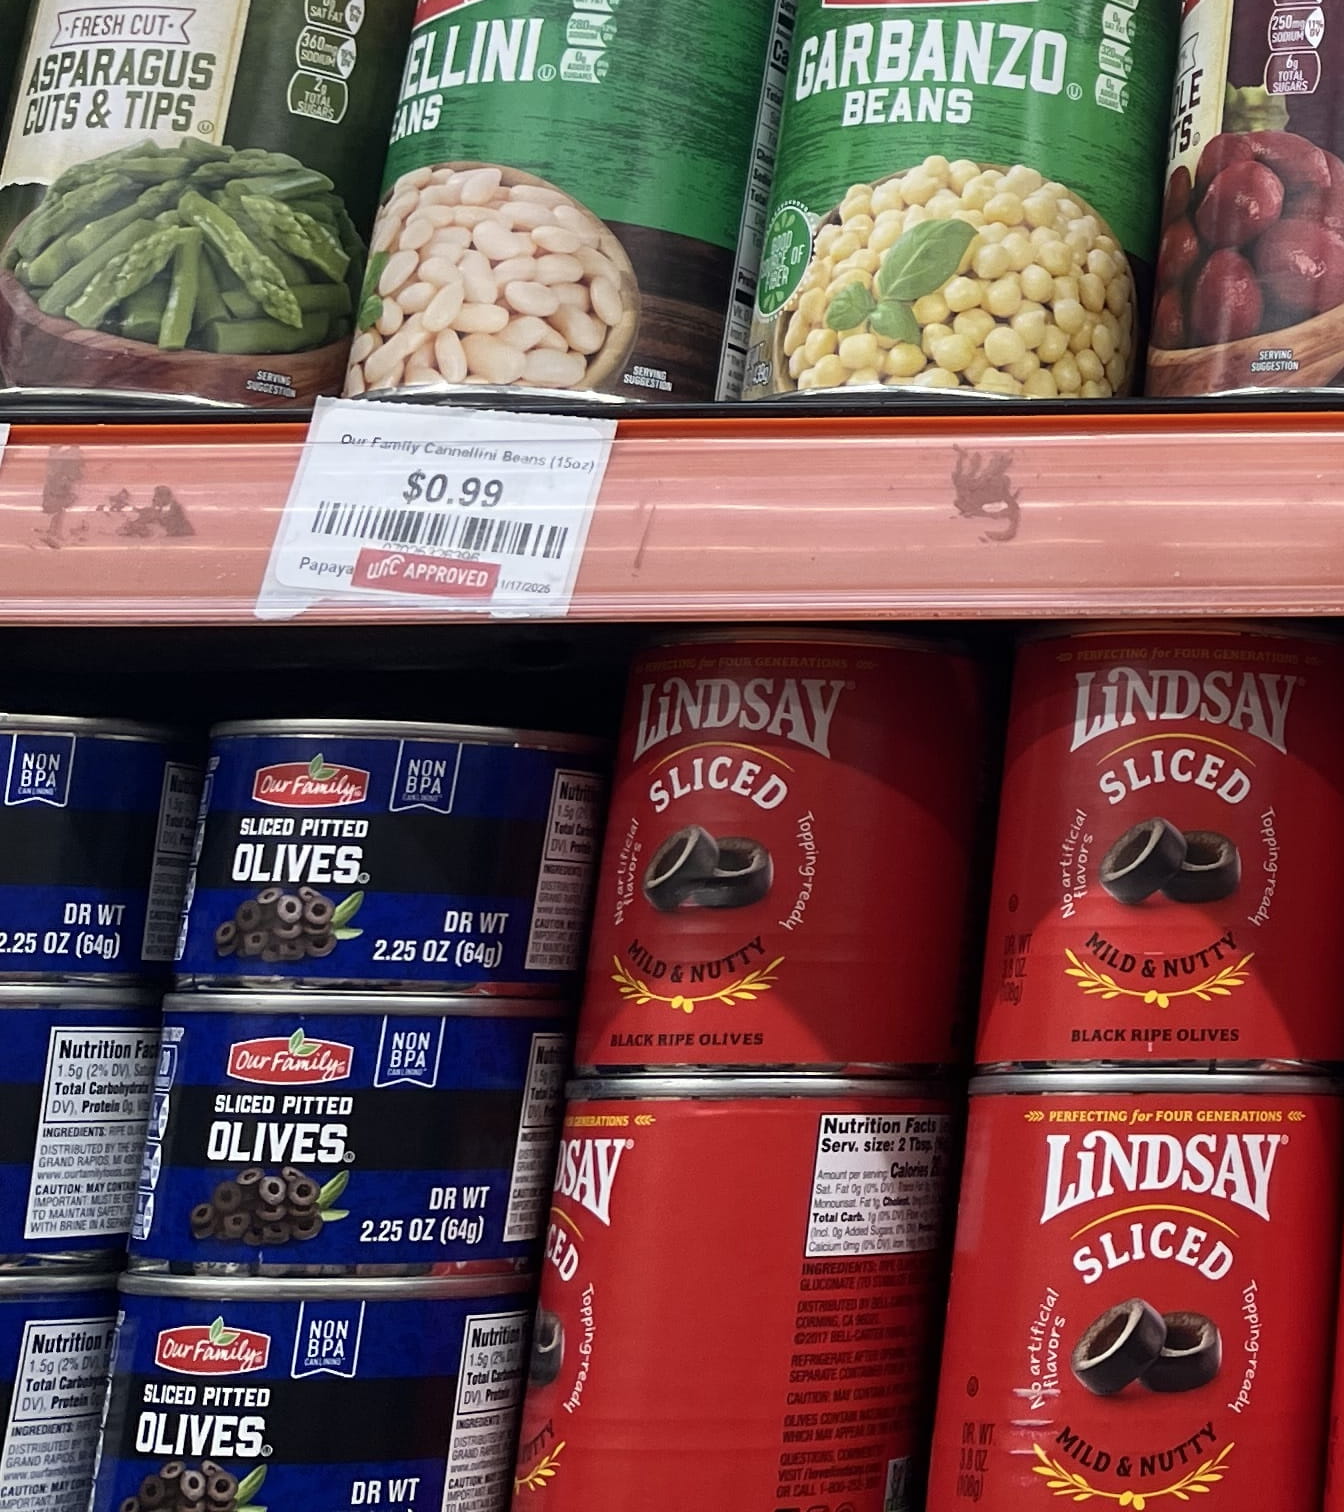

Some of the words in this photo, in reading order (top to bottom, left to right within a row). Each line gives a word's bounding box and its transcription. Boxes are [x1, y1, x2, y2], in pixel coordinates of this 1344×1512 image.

[796, 19, 1067, 101] GARBANZO
[1251, 359, 1299, 372] SUGGESTION
[1260, 350, 1292, 361] SERVING
[342, 434, 366, 446] Our
[370, 436, 419, 455] Family
[424, 442, 497, 461] Cannellini
[502, 450, 545, 466] Beans
[550, 455, 595, 472] (15oz)
[403, 469, 503, 507] $0.99
[299, 557, 353, 579] Papaya
[404, 563, 488, 587] APPROVED
[240, 818, 294, 837] SLICED
[301, 819, 368, 837] PITTED
[231, 844, 363, 883] OLIVES
[444, 912, 472, 933] DR
[479, 913, 508, 934] WT
[373, 939, 415, 962] 2.25
[423, 941, 450, 963] OZ
[455, 942, 502, 968] (64g)
[59, 1039, 133, 1060] Nutrition
[43, 1126, 108, 1137] INGREDIENTS:
[824, 1118, 900, 1136] Nutrition
[905, 1119, 936, 1134] Facts
[821, 1138, 859, 1152] Serv.
[864, 1137, 895, 1152] size:
[898, 1138, 905, 1152] 2
